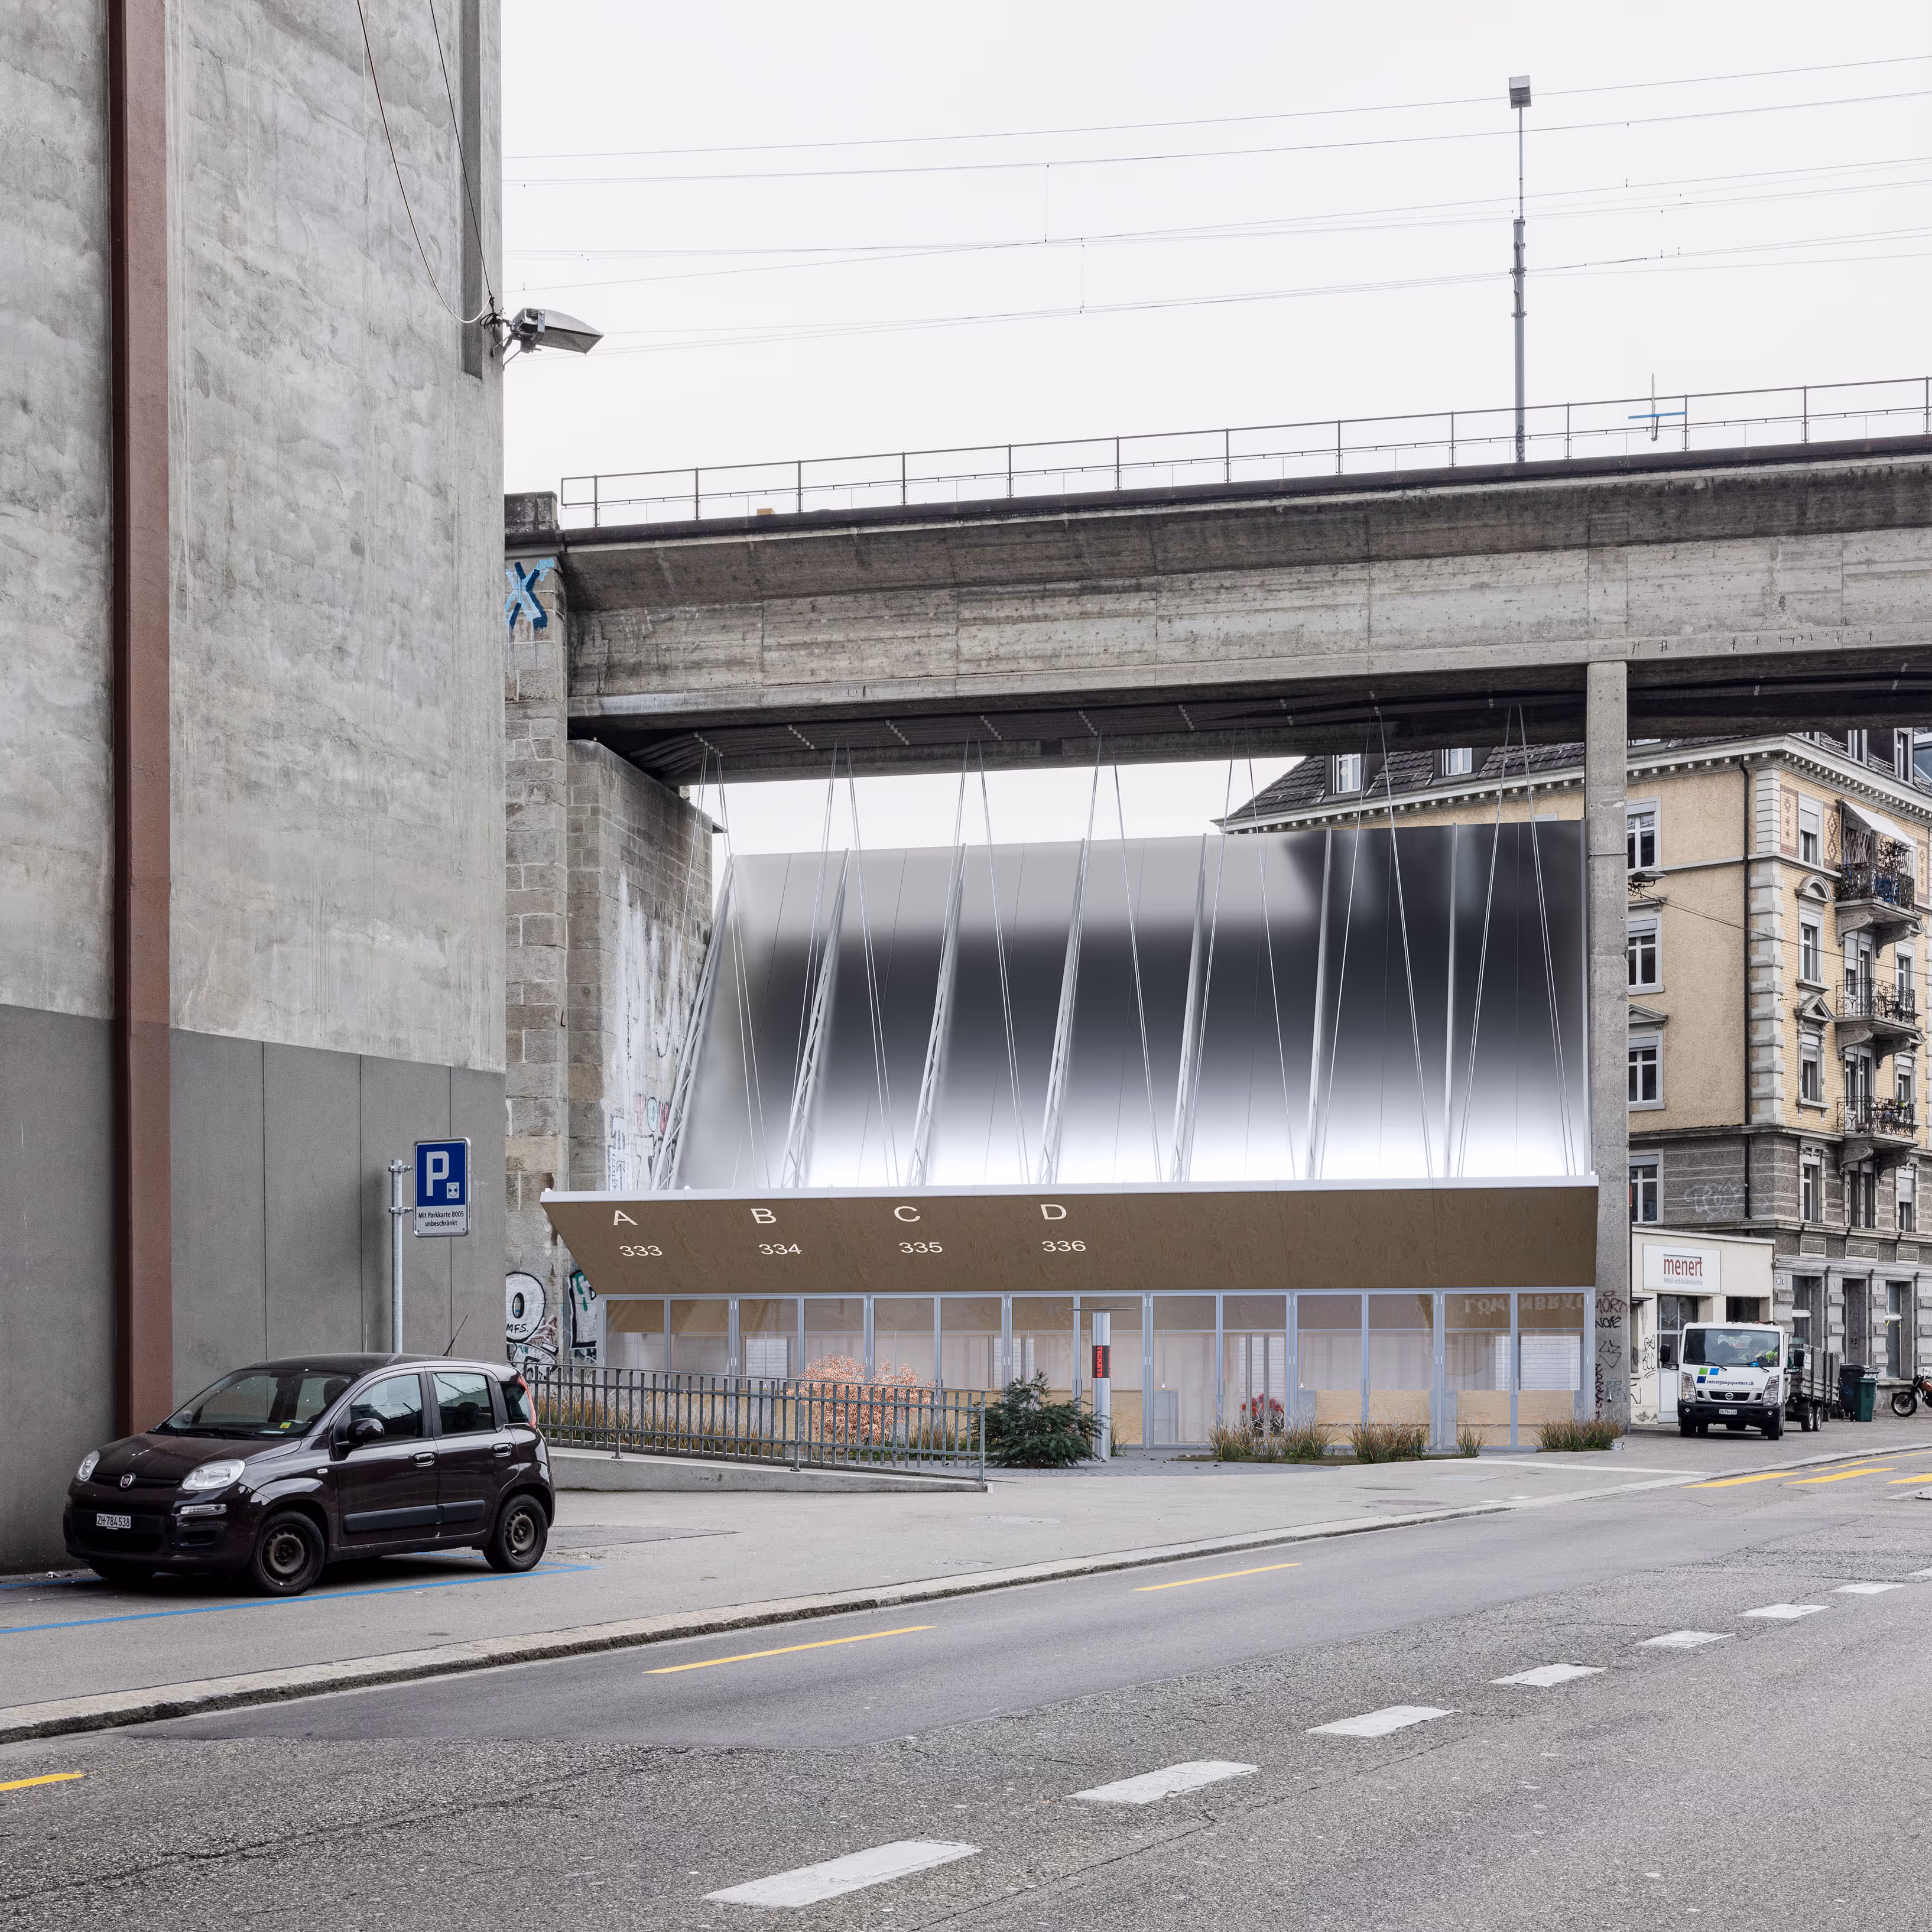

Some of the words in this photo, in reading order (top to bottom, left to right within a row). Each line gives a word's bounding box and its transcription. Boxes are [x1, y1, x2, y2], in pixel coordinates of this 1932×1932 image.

[427, 1151, 449, 1196] P
[613, 1210, 638, 1226] A
[751, 1208, 777, 1224] B
[894, 1206, 921, 1222] C
[1040, 1204, 1067, 1220] D
[619, 1245, 663, 1256] 333
[758, 1243, 802, 1255] 334
[899, 1242, 943, 1253] 335
[1041, 1241, 1086, 1252] 336
[1664, 1257, 1703, 1277] menert
